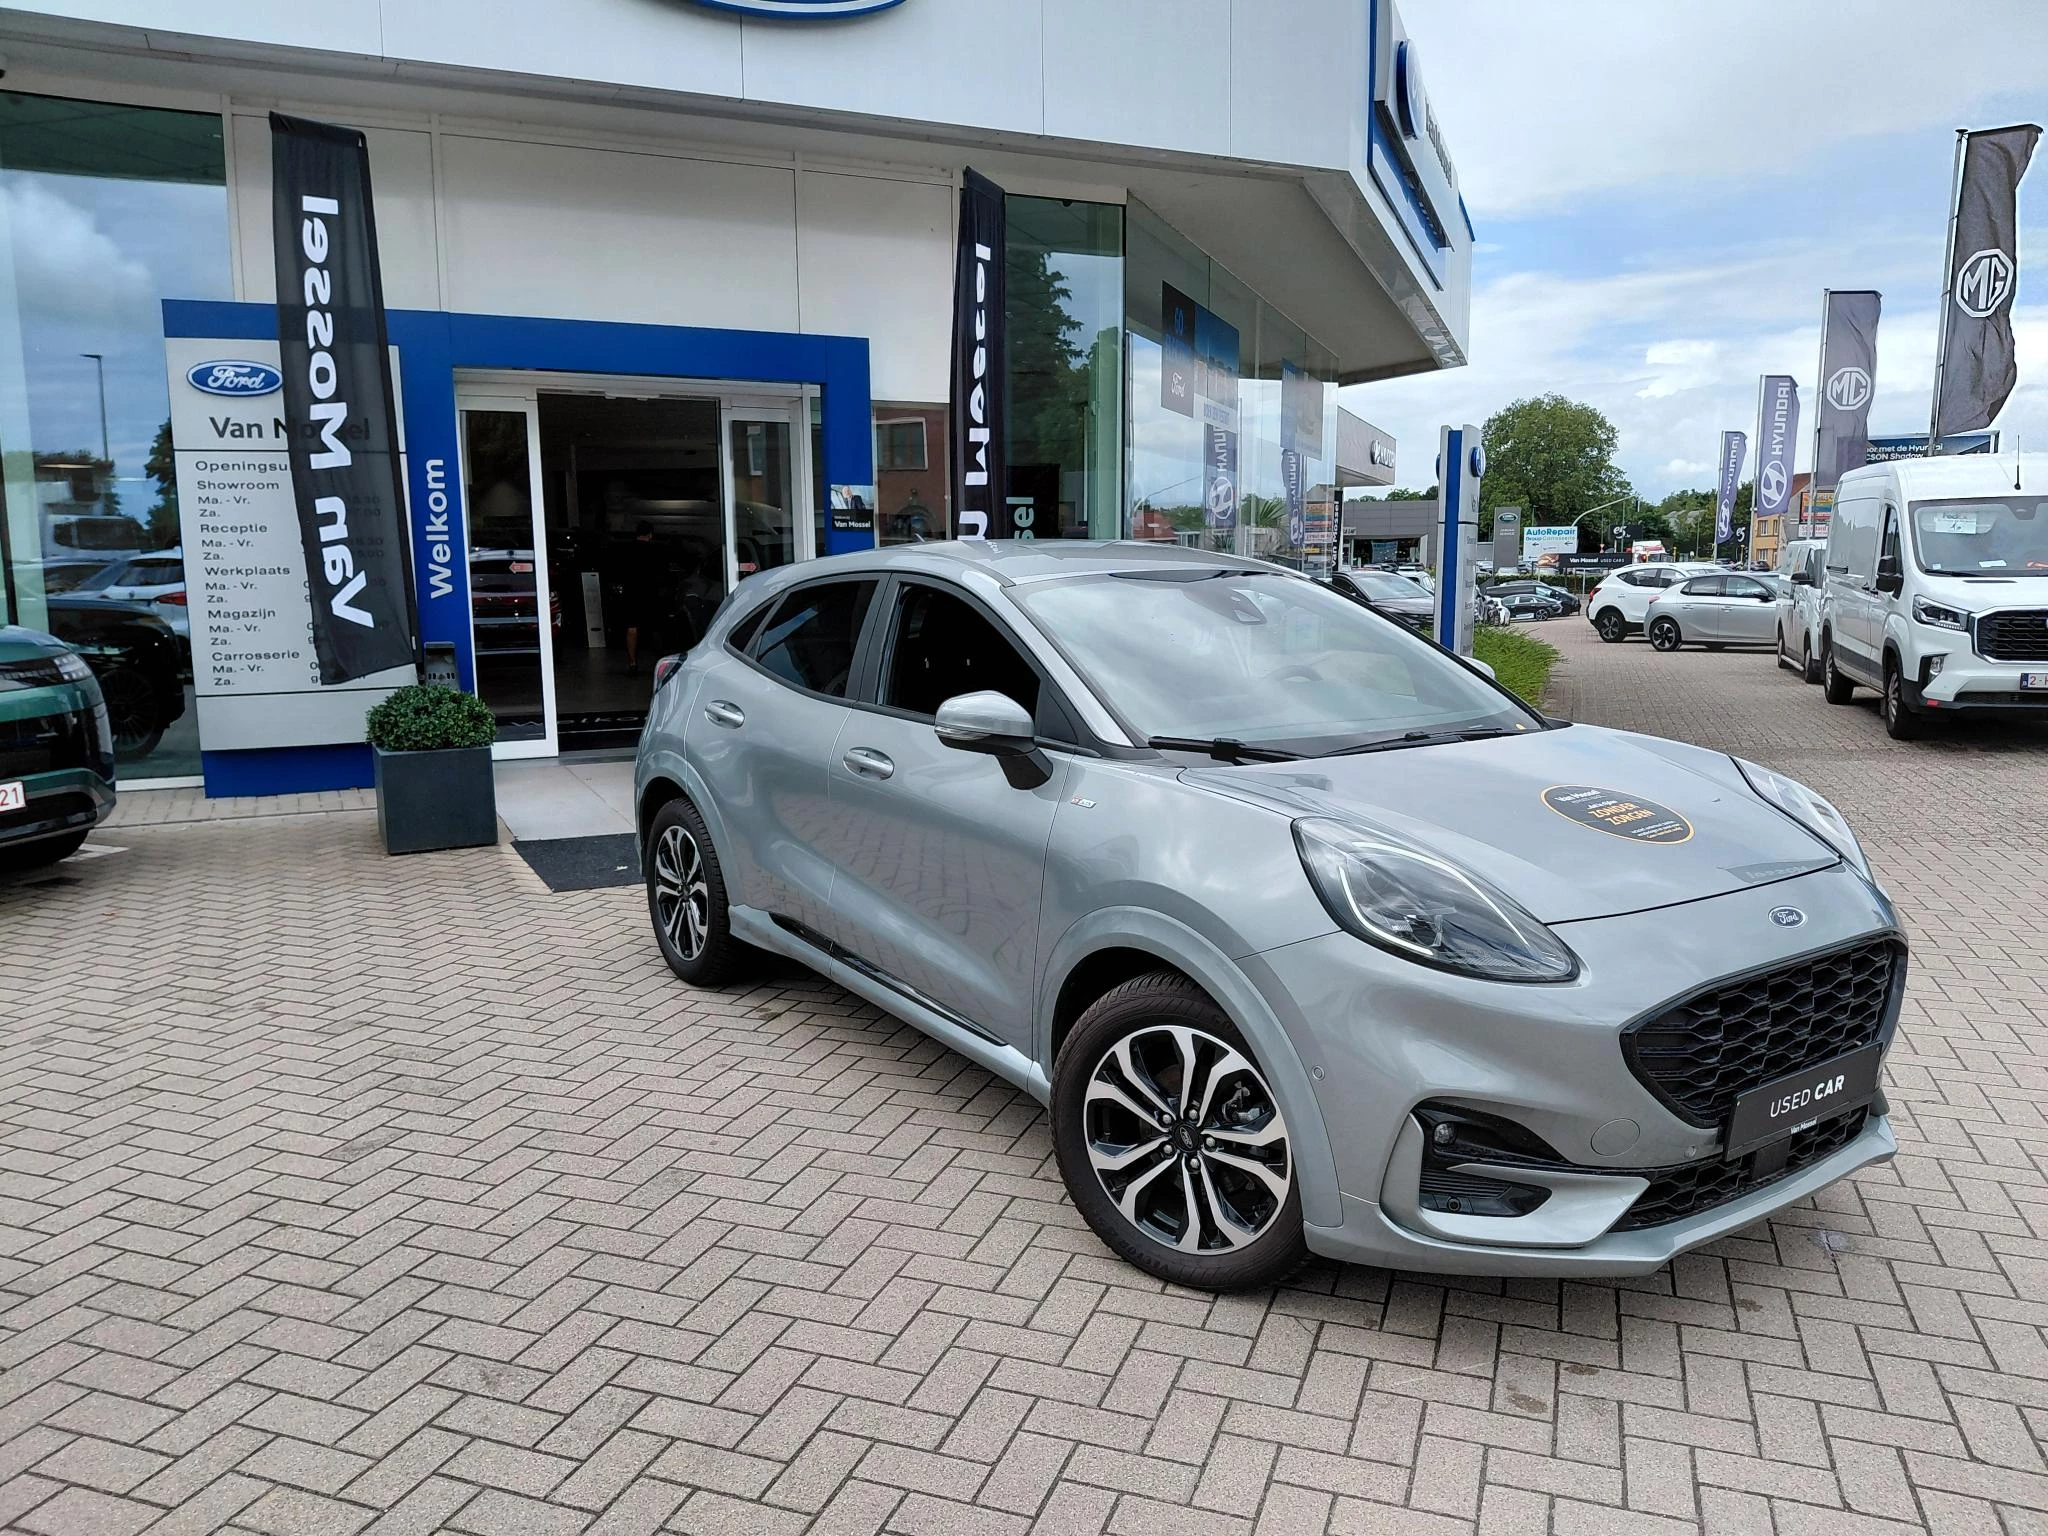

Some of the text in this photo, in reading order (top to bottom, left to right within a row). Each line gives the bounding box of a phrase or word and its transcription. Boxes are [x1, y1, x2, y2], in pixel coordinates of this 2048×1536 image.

[1964, 258, 2007, 309] MG
[207, 365, 265, 389] Ford
[1832, 372, 1867, 405] MG
[1772, 382, 1791, 455] HYUNDAI
[209, 416, 264, 439] Van
[197, 480, 280, 490] Showroom
[200, 524, 268, 534] Receptie
[427, 459, 453, 599] Welkom
[1526, 528, 1576, 537] AutoRepair
[205, 566, 291, 577] Werkplaats
[208, 608, 276, 620] Magazijn
[212, 649, 300, 661] Carrosserie
[1588, 802, 1641, 818] ZONDER
[1605, 808, 1656, 826] ZORGEN
[1777, 911, 1799, 924] Ford
[1770, 1074, 1845, 1118] USED CAR
